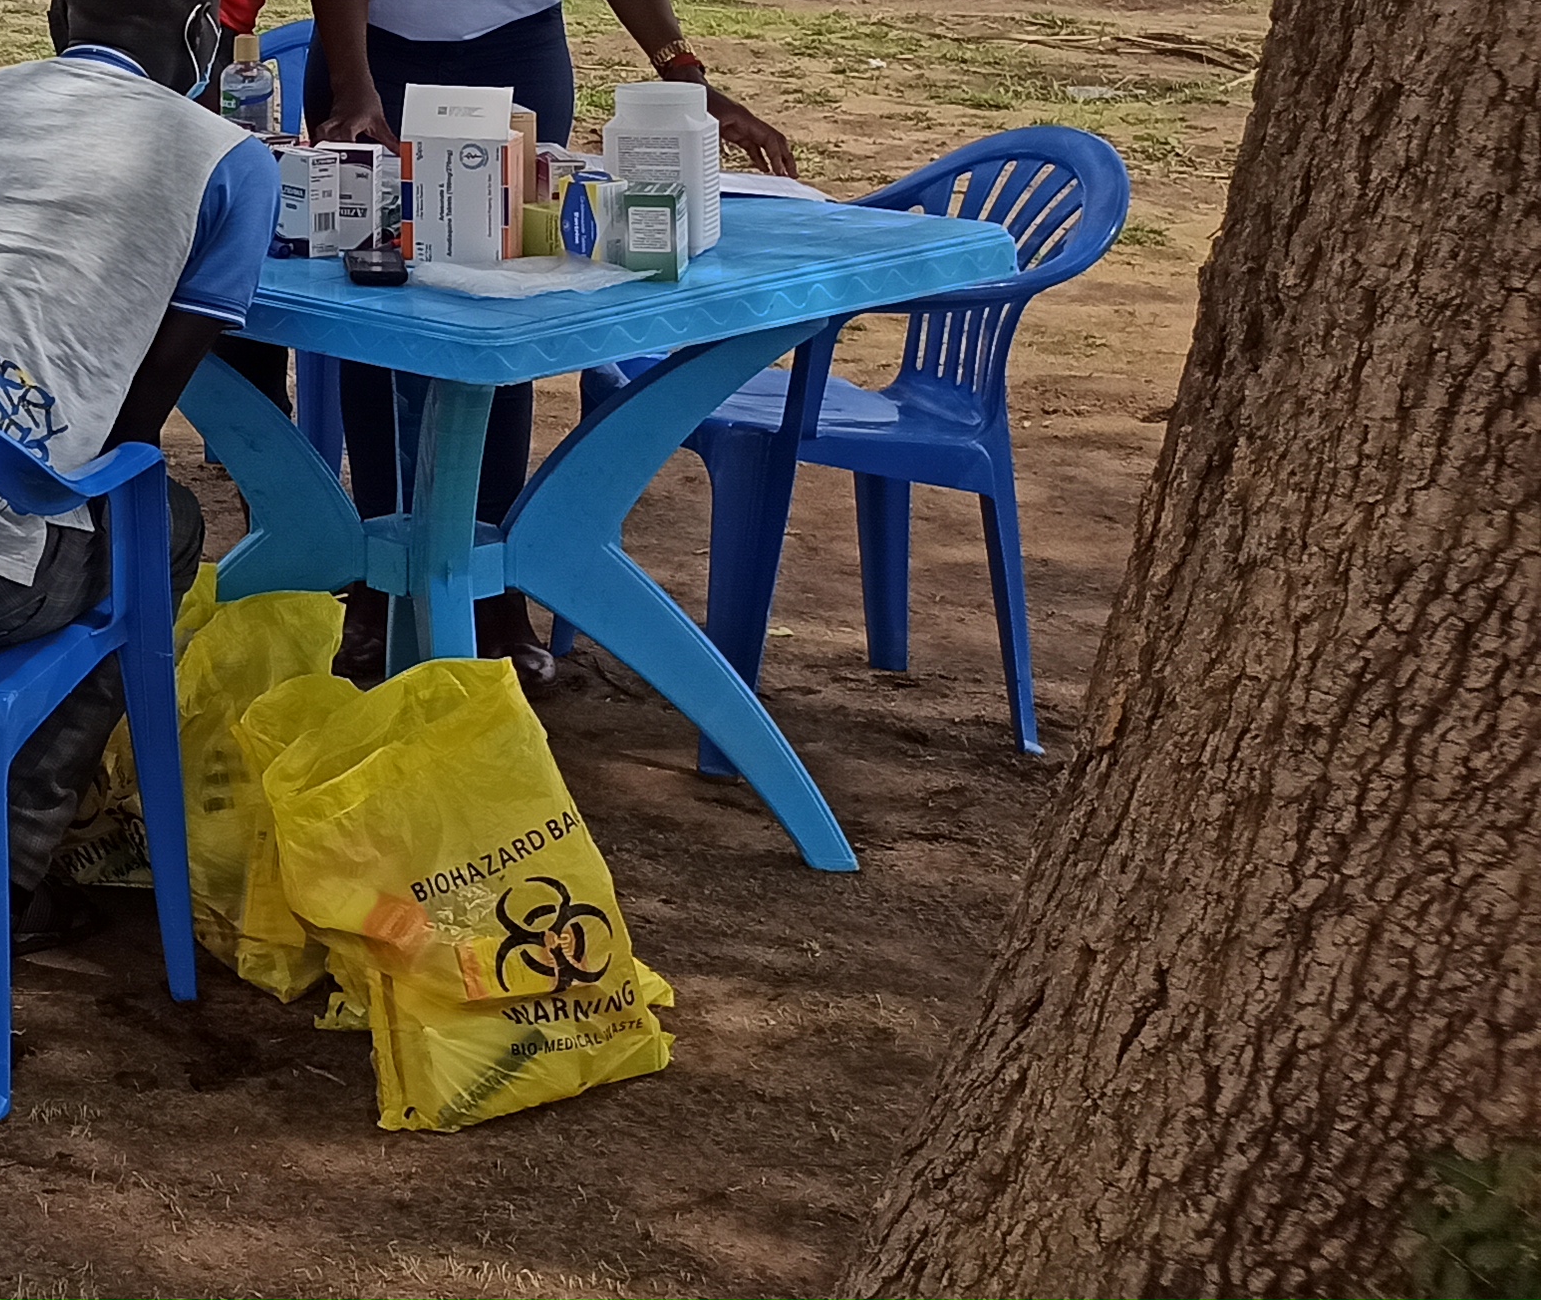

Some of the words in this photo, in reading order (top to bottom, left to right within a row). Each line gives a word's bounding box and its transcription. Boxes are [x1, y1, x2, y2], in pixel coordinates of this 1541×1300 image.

[410, 829, 547, 903] BIOHAZARD
[545, 810, 583, 842] BA
[502, 979, 636, 1027] WARNING
[511, 1031, 603, 1057] BIO-MEDICAL
[603, 1018, 644, 1043] WASTE
